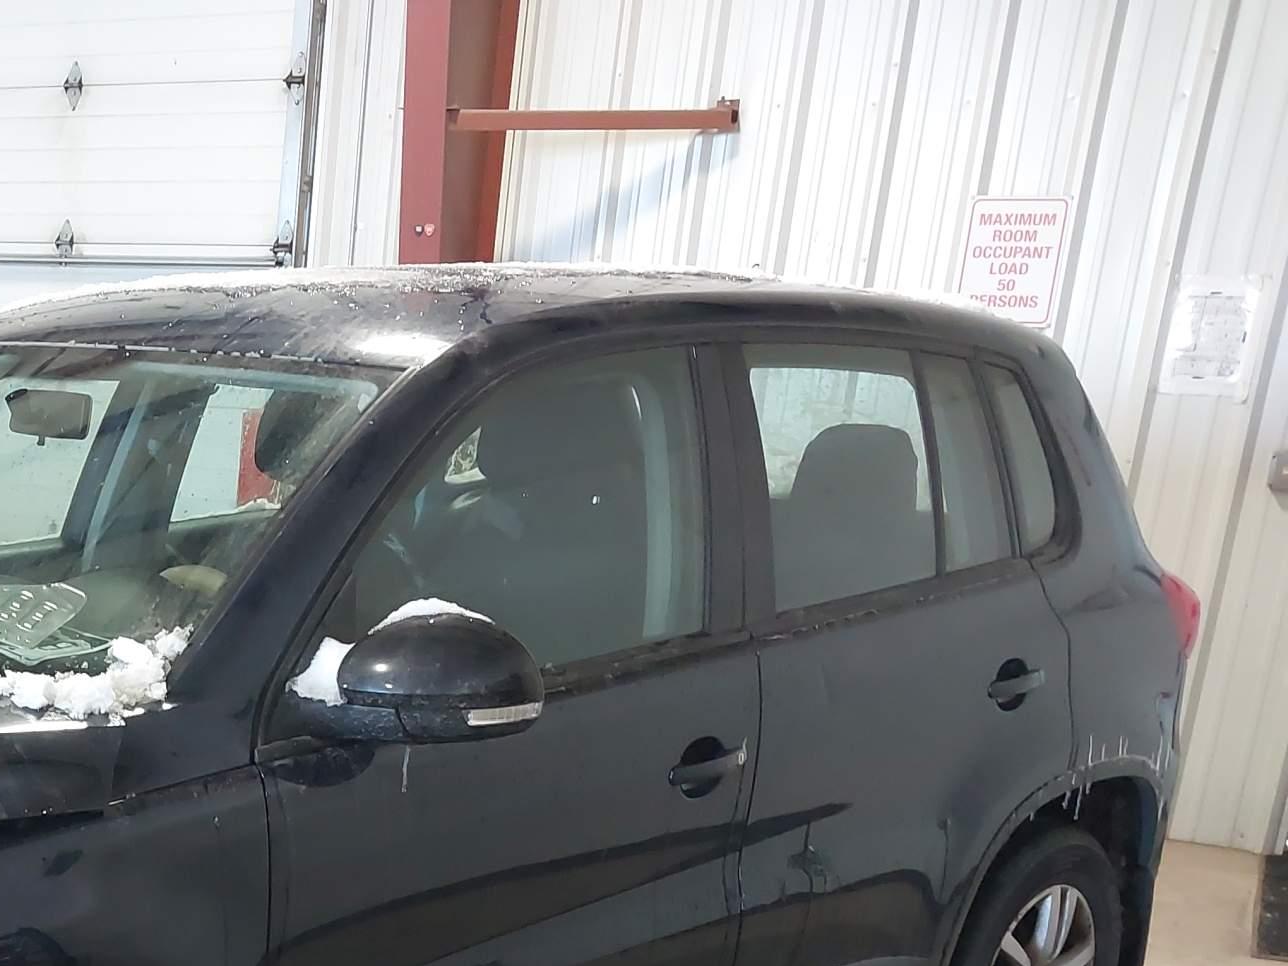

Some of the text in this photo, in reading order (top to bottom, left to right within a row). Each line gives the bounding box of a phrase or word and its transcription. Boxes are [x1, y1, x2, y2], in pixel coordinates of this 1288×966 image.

[978, 213, 1057, 226] MAXIMUM
[992, 229, 1038, 242] ROOM
[972, 246, 1053, 259] OCCUPANT
[989, 262, 1029, 275] LOAD
[996, 279, 1016, 291] 50
